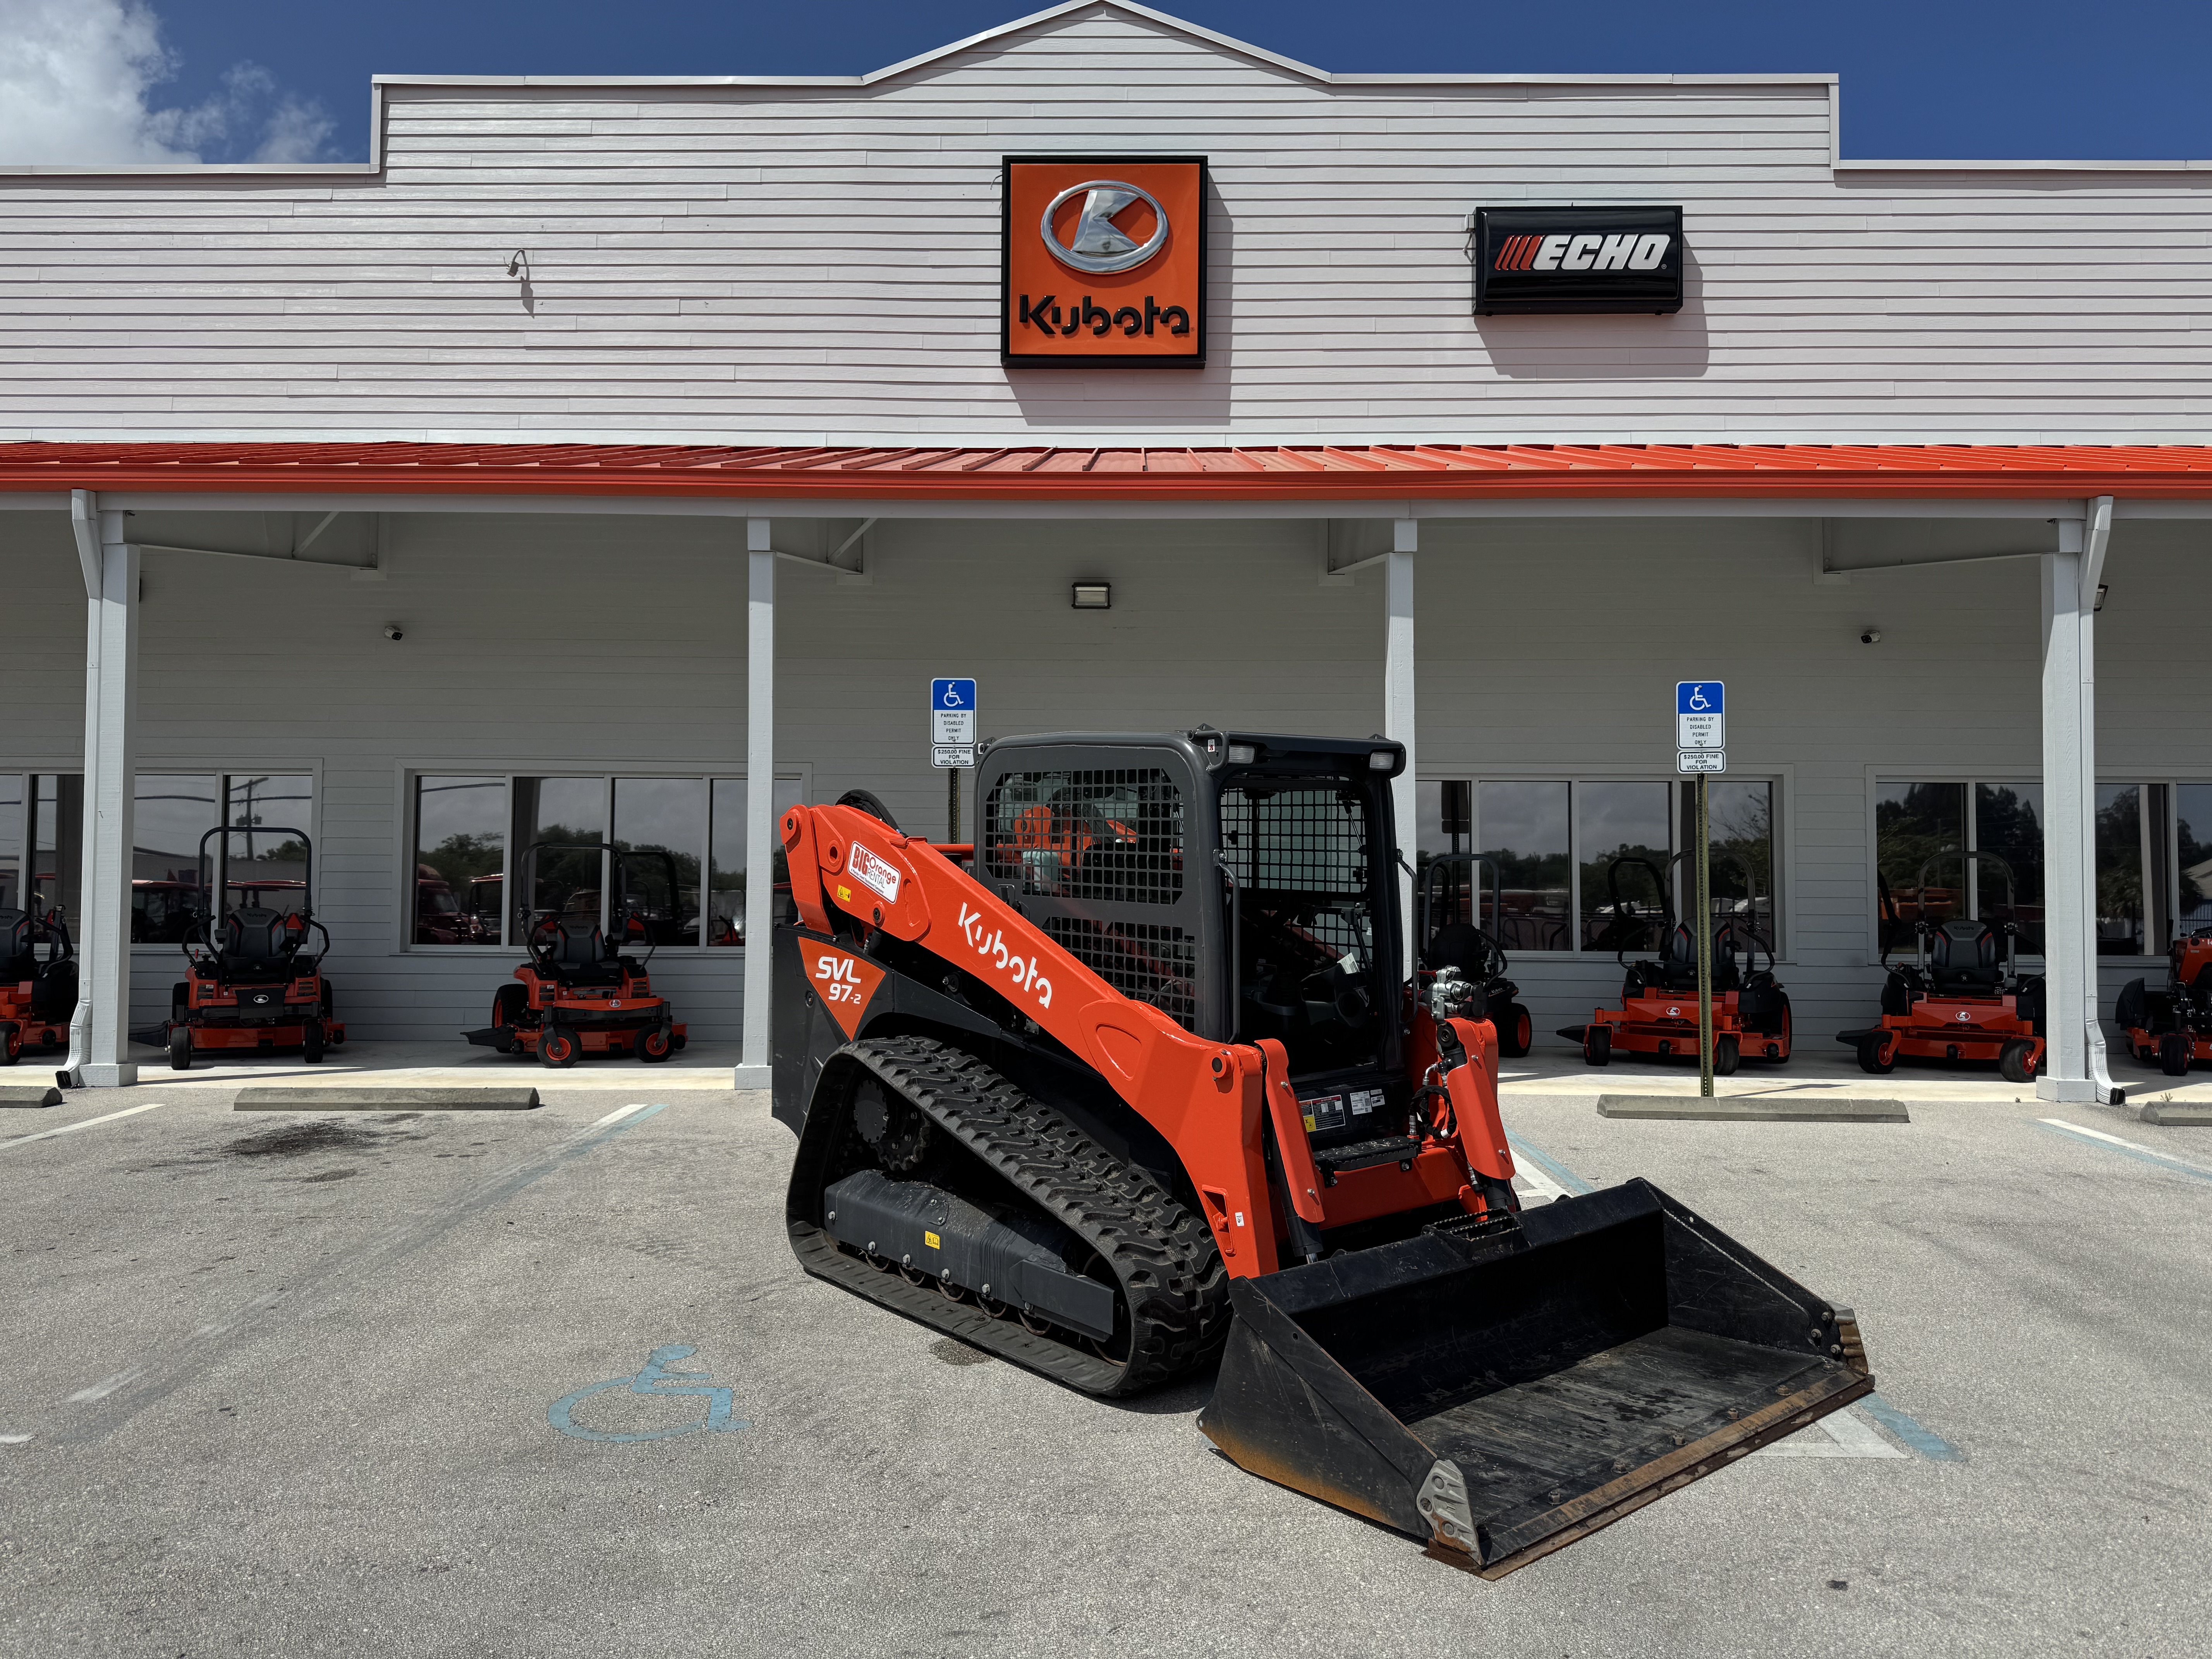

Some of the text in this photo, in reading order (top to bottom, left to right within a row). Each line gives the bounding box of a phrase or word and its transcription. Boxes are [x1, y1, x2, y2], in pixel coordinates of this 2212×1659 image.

[1532, 234, 1670, 270] ECHO
[1019, 294, 1190, 335] Kubota
[852, 846, 896, 884] BIG Orange
[867, 868, 885, 889] RENTAL
[815, 956, 861, 984] SVL
[958, 902, 1052, 1009] Kubota
[828, 983, 861, 1005] 97-2
